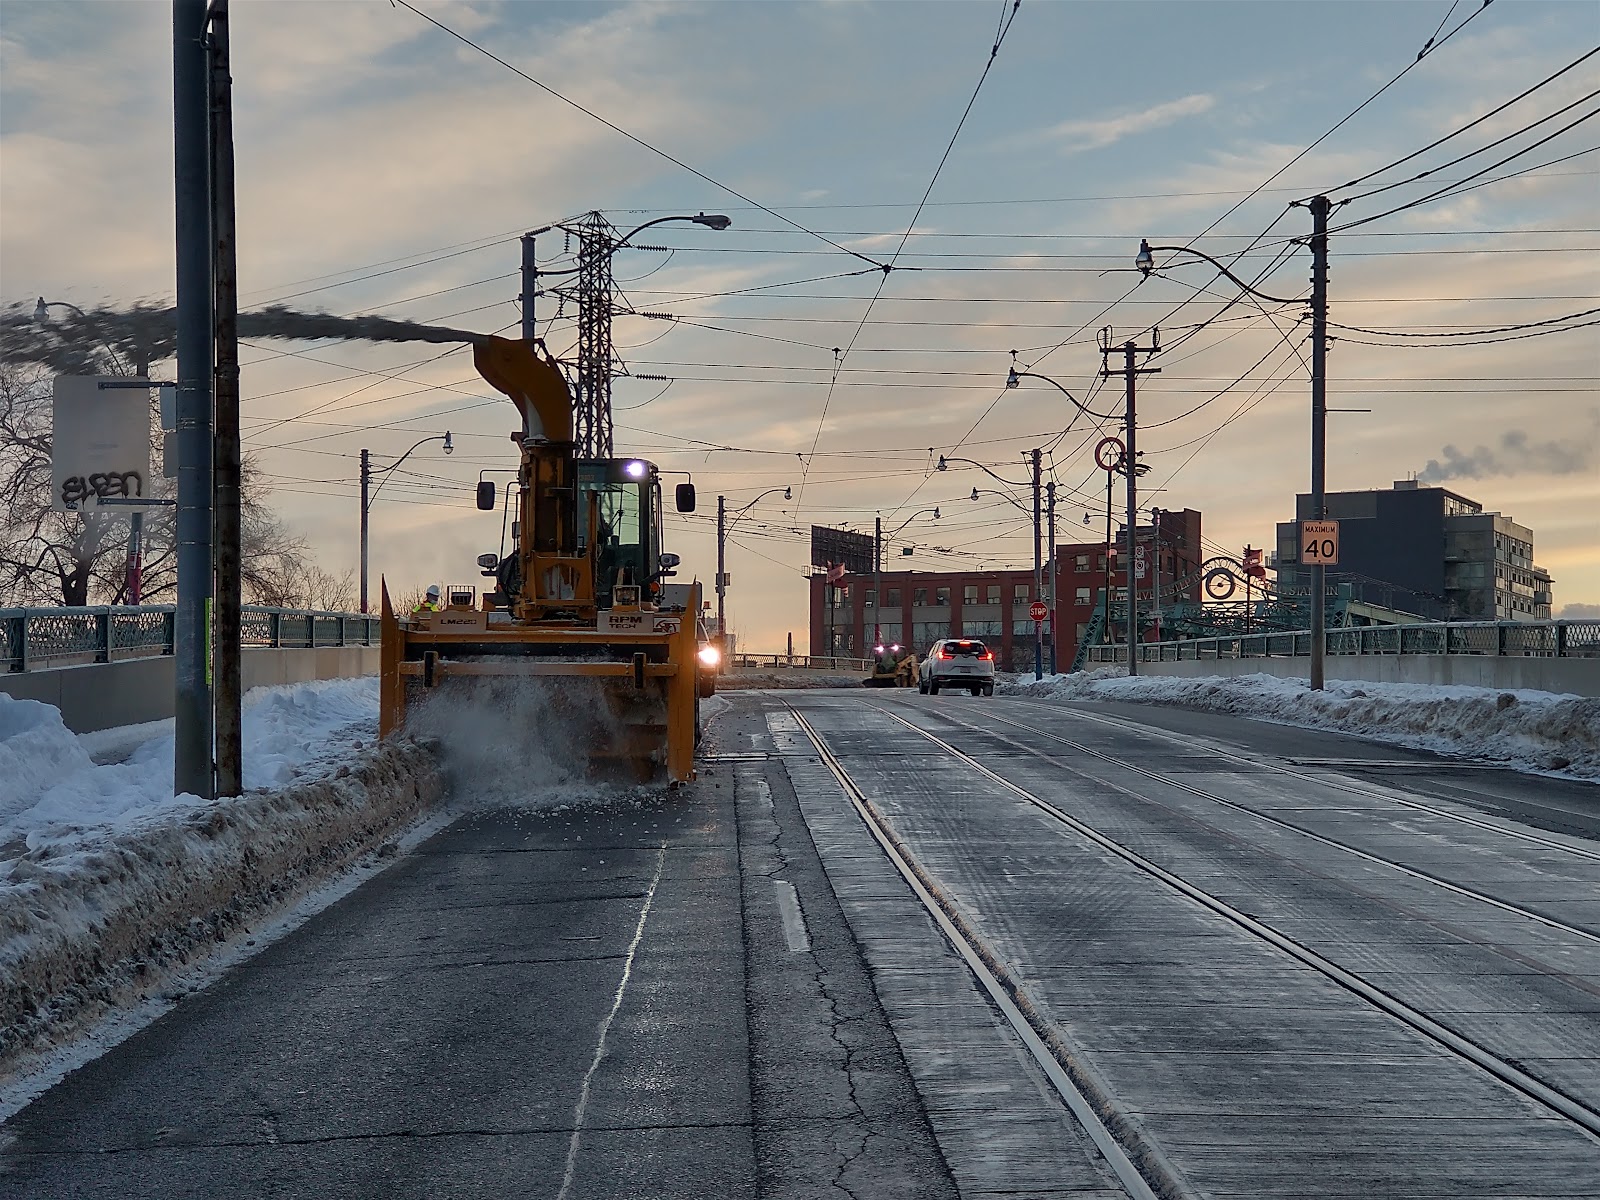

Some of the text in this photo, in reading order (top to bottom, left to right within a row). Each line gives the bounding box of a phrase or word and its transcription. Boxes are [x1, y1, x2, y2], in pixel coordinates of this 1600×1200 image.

[1305, 539, 1335, 558] 40
[1325, 586, 1340, 597] IN
[1030, 607, 1047, 616] STOP
